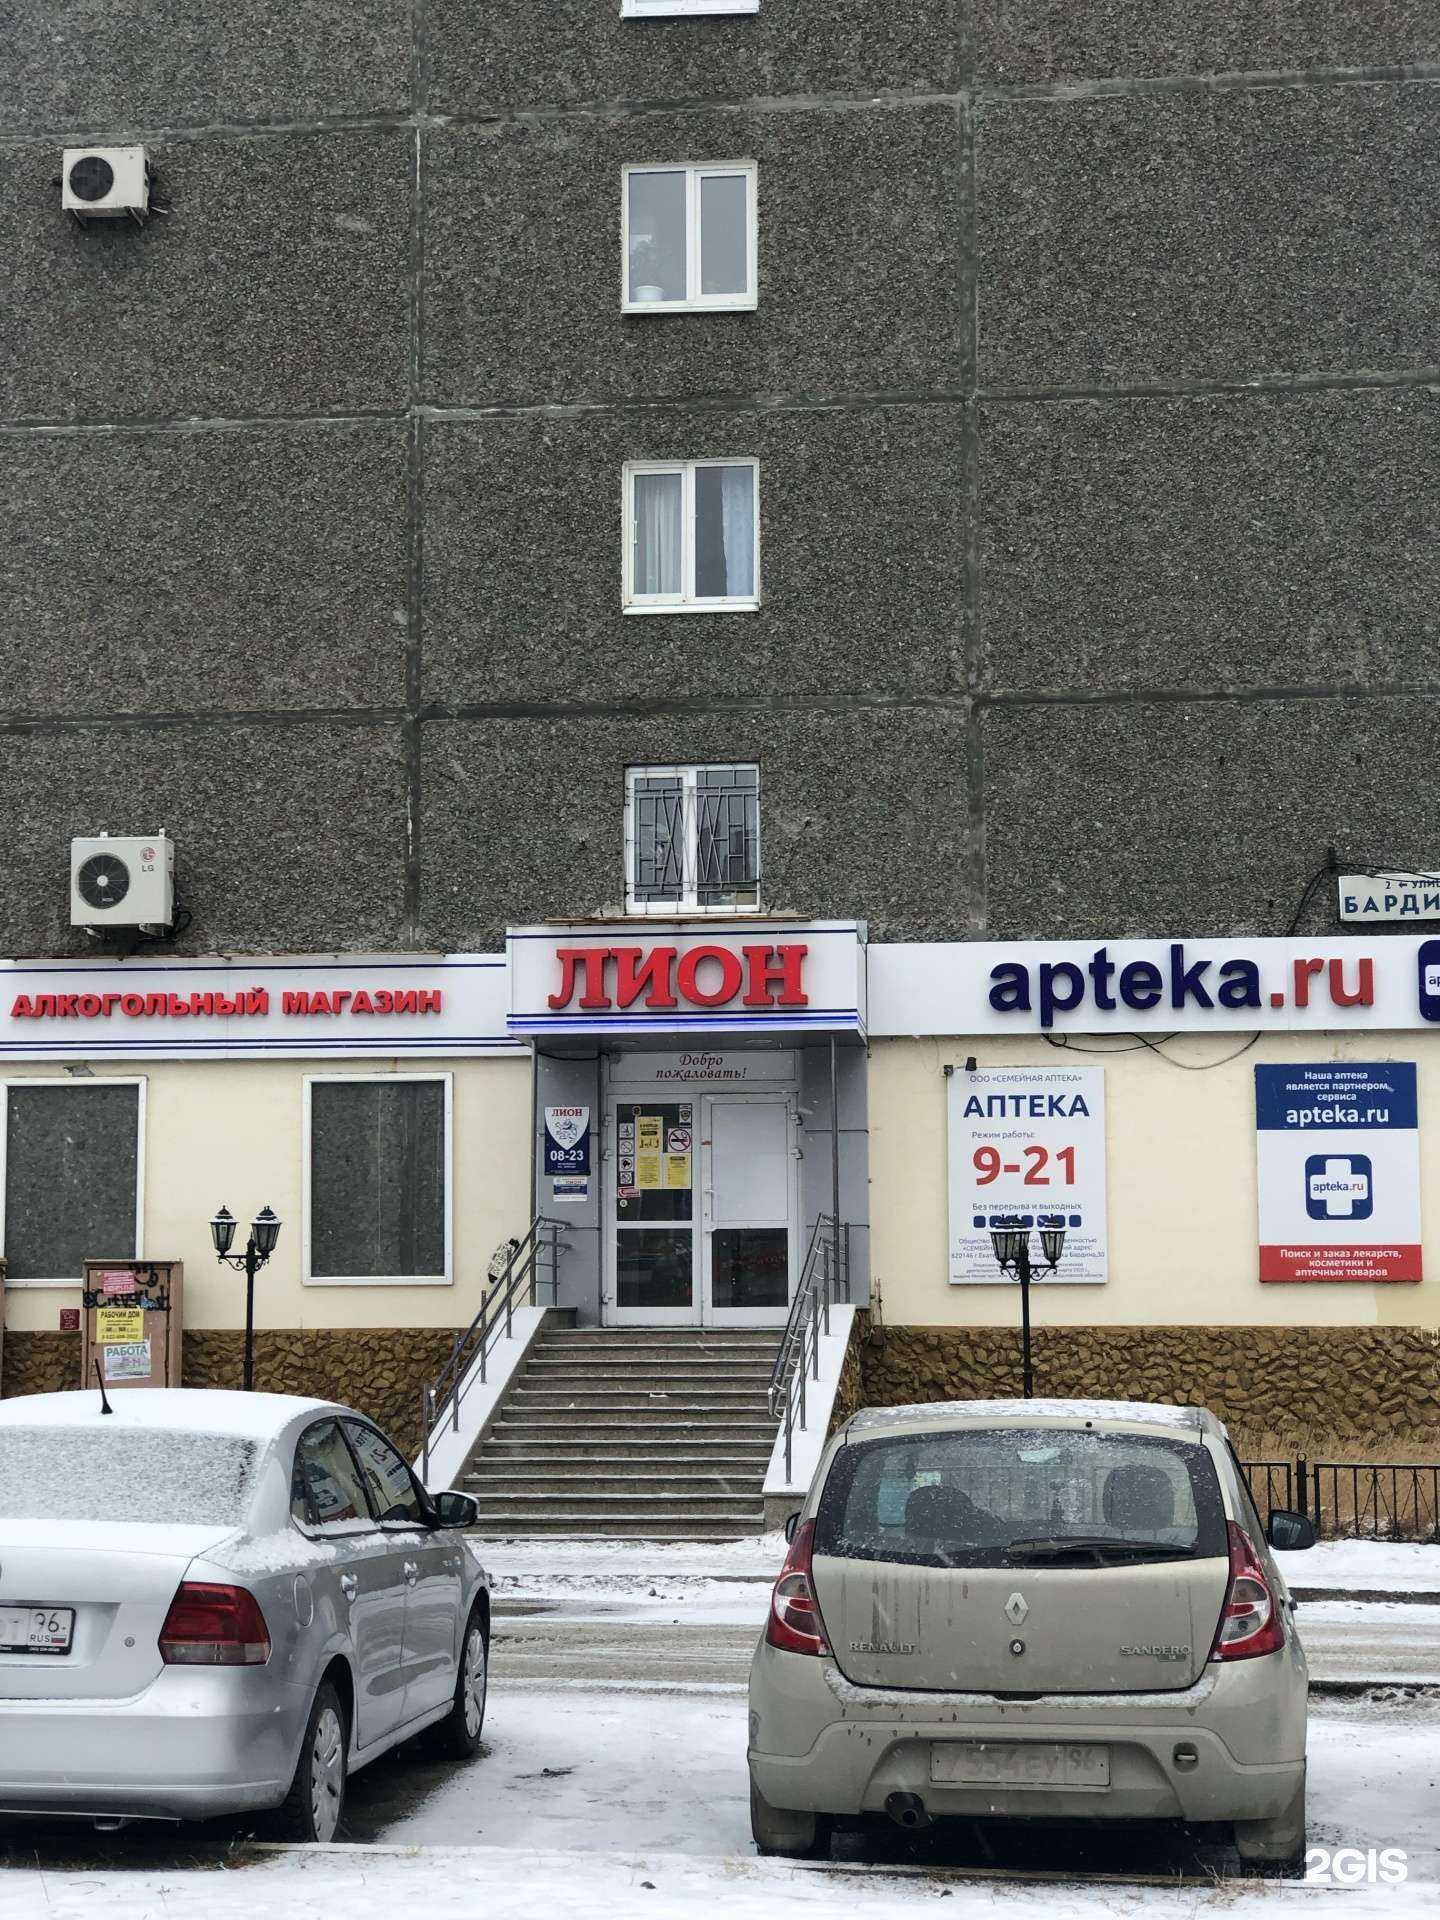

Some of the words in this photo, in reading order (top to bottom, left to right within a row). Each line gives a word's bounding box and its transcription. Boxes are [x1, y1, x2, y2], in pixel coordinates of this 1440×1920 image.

[141, 864, 154, 872] LG
[1385, 881, 1391, 889] 2
[548, 944, 808, 1009] ЛИОН
[989, 943, 1374, 1028] apteka.ru
[11, 986, 269, 1017] АЛКОГОЛЬНЫЙ
[282, 989, 442, 1014] МАГАЗИН
[680, 1052, 724, 1069] Добро
[656, 1067, 747, 1081] пожаловать!
[969, 1075, 990, 1083] ООО
[1045, 1074, 1082, 1082] АПТЕКА»
[1304, 1071, 1332, 1080] Наша
[1334, 1071, 1369, 1080] аптека
[1286, 1082, 1330, 1091] является
[1332, 1081, 1388, 1091] партнером
[1317, 1093, 1357, 1102] сервиса
[963, 1094, 1090, 1118] АПТЕКА
[552, 1108, 583, 1117] ЛИОН
[1286, 1104, 1389, 1127] apteka.ru
[550, 1150, 584, 1161] 08-23
[972, 1145, 1075, 1186] 9-21
[1312, 1182, 1364, 1193] apteka.ru
[989, 1203, 1030, 1212] перерыва
[1039, 1203, 1082, 1211] выходных
[1280, 1250, 1311, 1259] Поиск
[1323, 1250, 1351, 1258] заказ
[1353, 1250, 1403, 1260] лекарств,
[1309, 1259, 1364, 1267] косметики
[1366, 1259, 1373, 1267] и
[1295, 1268, 1344, 1277] аптечных
[1346, 1267, 1388, 1277] товаров
[106, 1345, 148, 1357] РАБОТА
[30, 1634, 50, 1642] RUS
[849, 1641, 915, 1654] RENAULT
[1120, 1645, 1193, 1656] SANDERO
